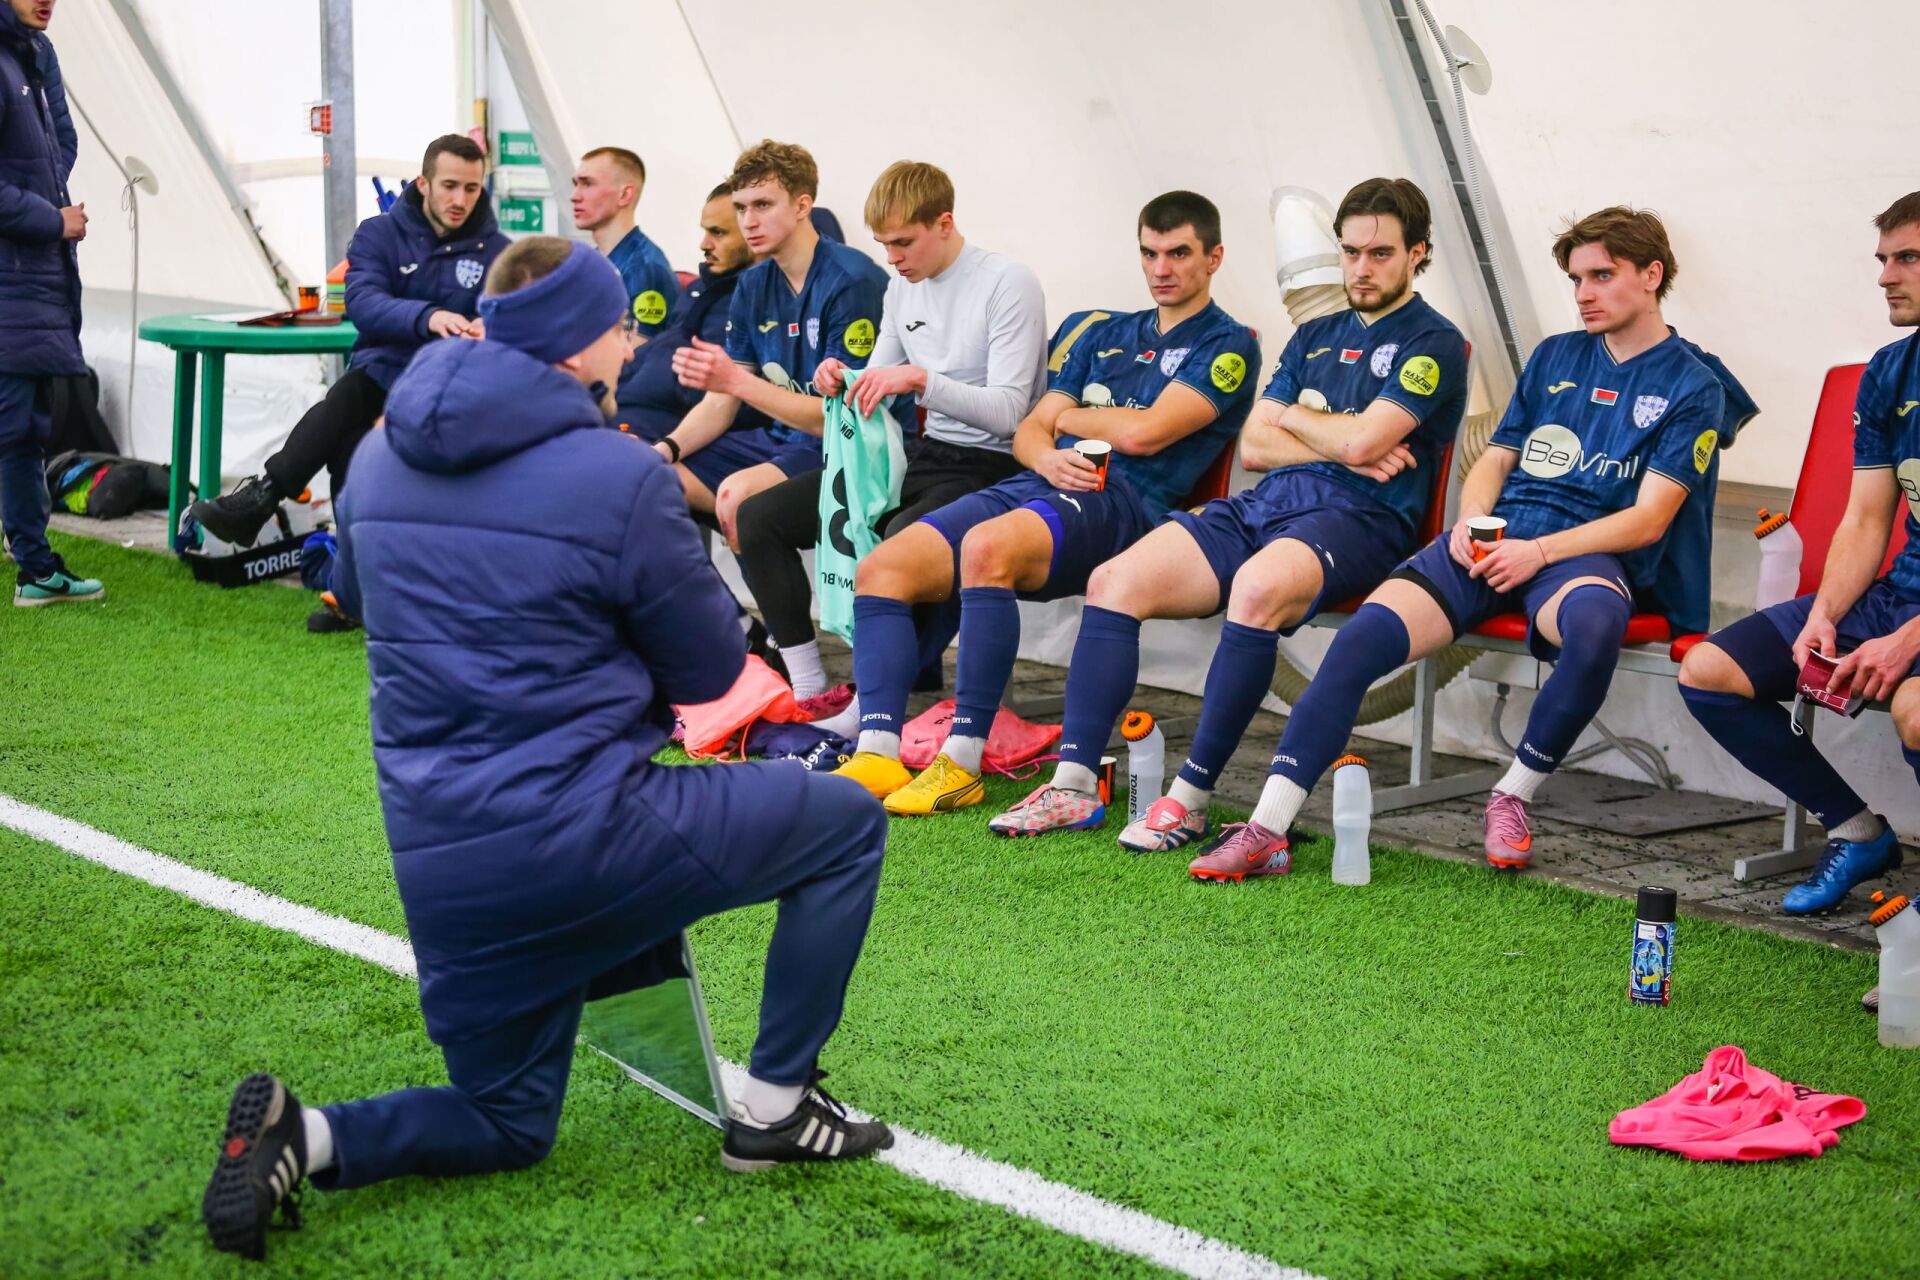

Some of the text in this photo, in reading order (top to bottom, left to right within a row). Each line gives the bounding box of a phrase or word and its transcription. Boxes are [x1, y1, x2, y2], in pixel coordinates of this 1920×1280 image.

[1525, 439, 1639, 479] BelVinil
[244, 549, 304, 580] TORRE
[1129, 773, 1138, 816] TORRES
